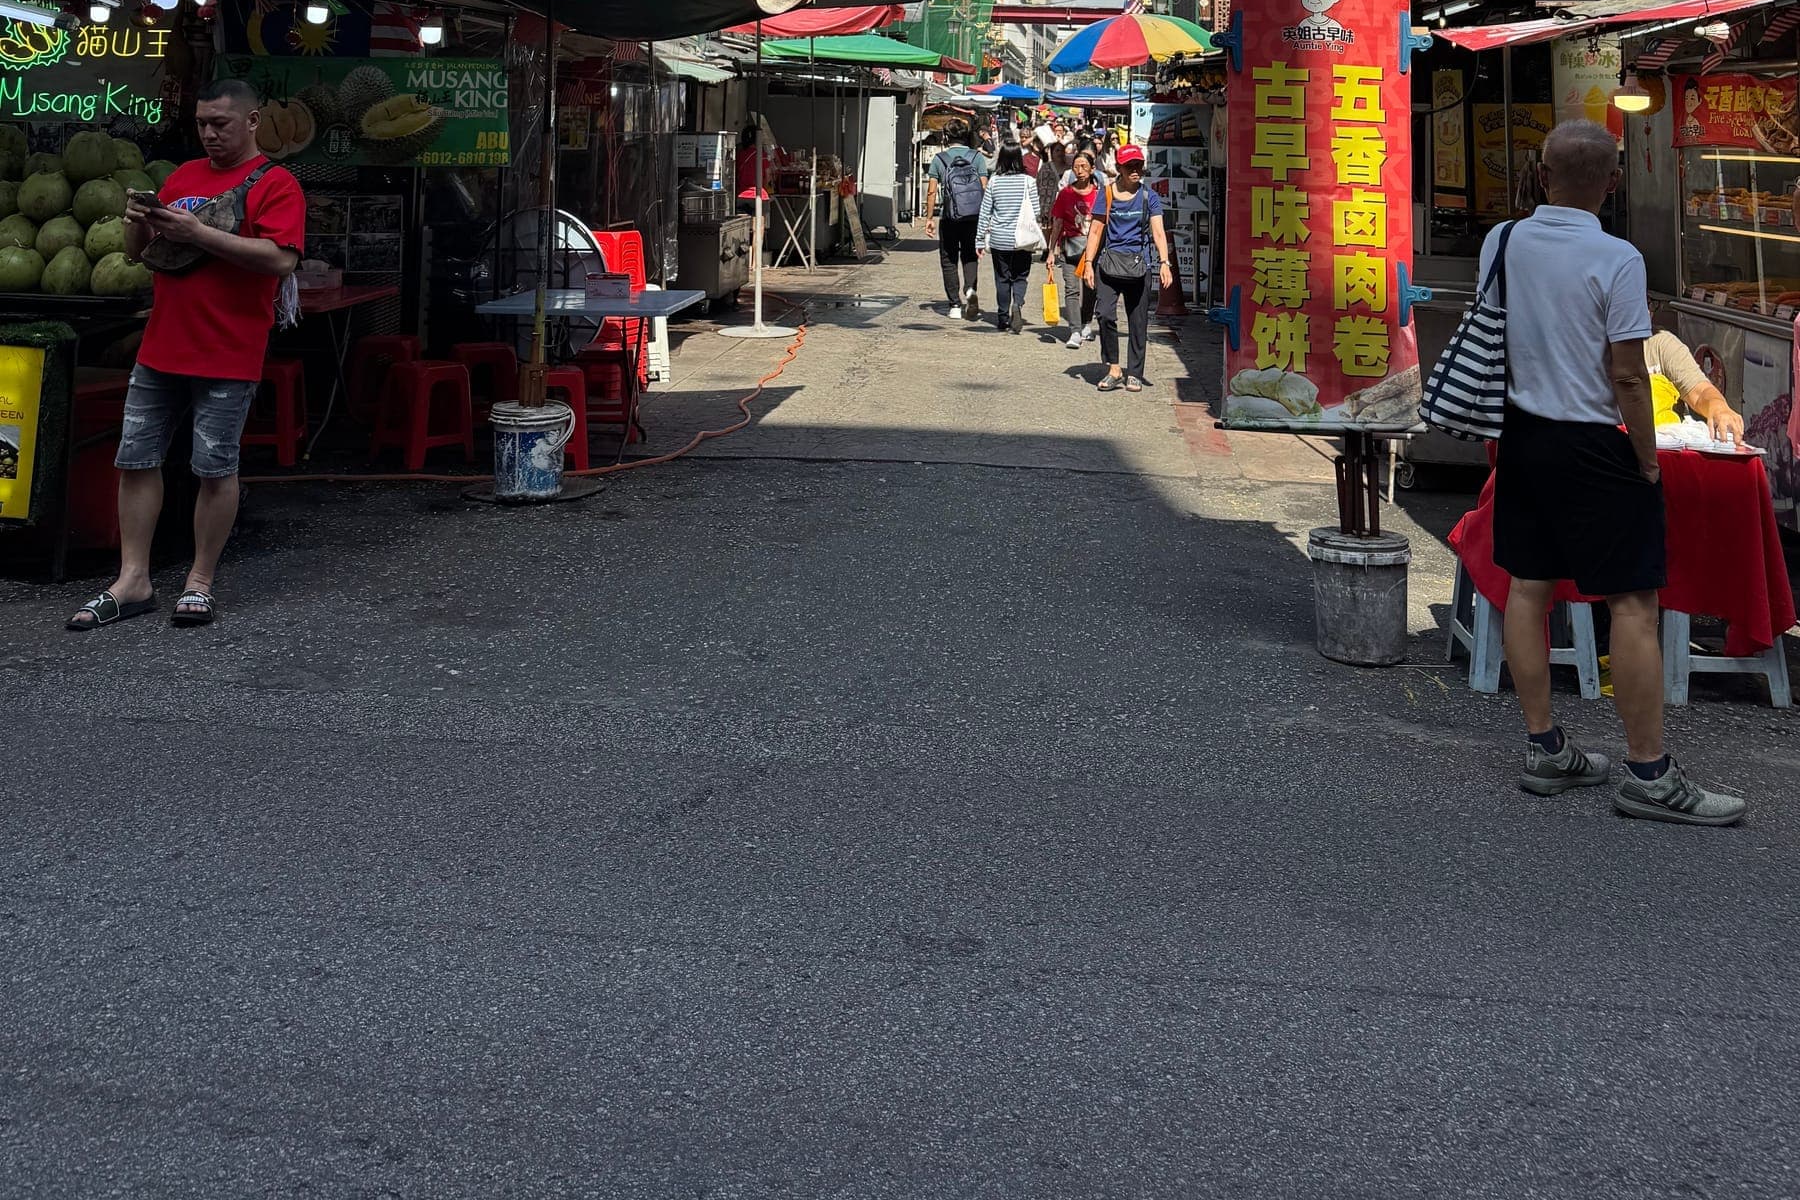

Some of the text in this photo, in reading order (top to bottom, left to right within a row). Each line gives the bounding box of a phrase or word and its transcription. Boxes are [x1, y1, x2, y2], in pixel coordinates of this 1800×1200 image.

[76, 24, 172, 58] 猫山王
[1282, 25, 1355, 44] 英姐古早味
[1293, 42, 1345, 54] Auntie Ying
[406, 70, 509, 89] MUSANG
[0, 76, 98, 121] Musang
[105, 81, 164, 124] King
[454, 89, 509, 108] KING
[475, 131, 509, 150] ABU
[1250, 60, 1311, 373] 古早味薄饼
[1331, 63, 1392, 377] 五香卤肉卷
[0, 409, 24, 420] EEN
